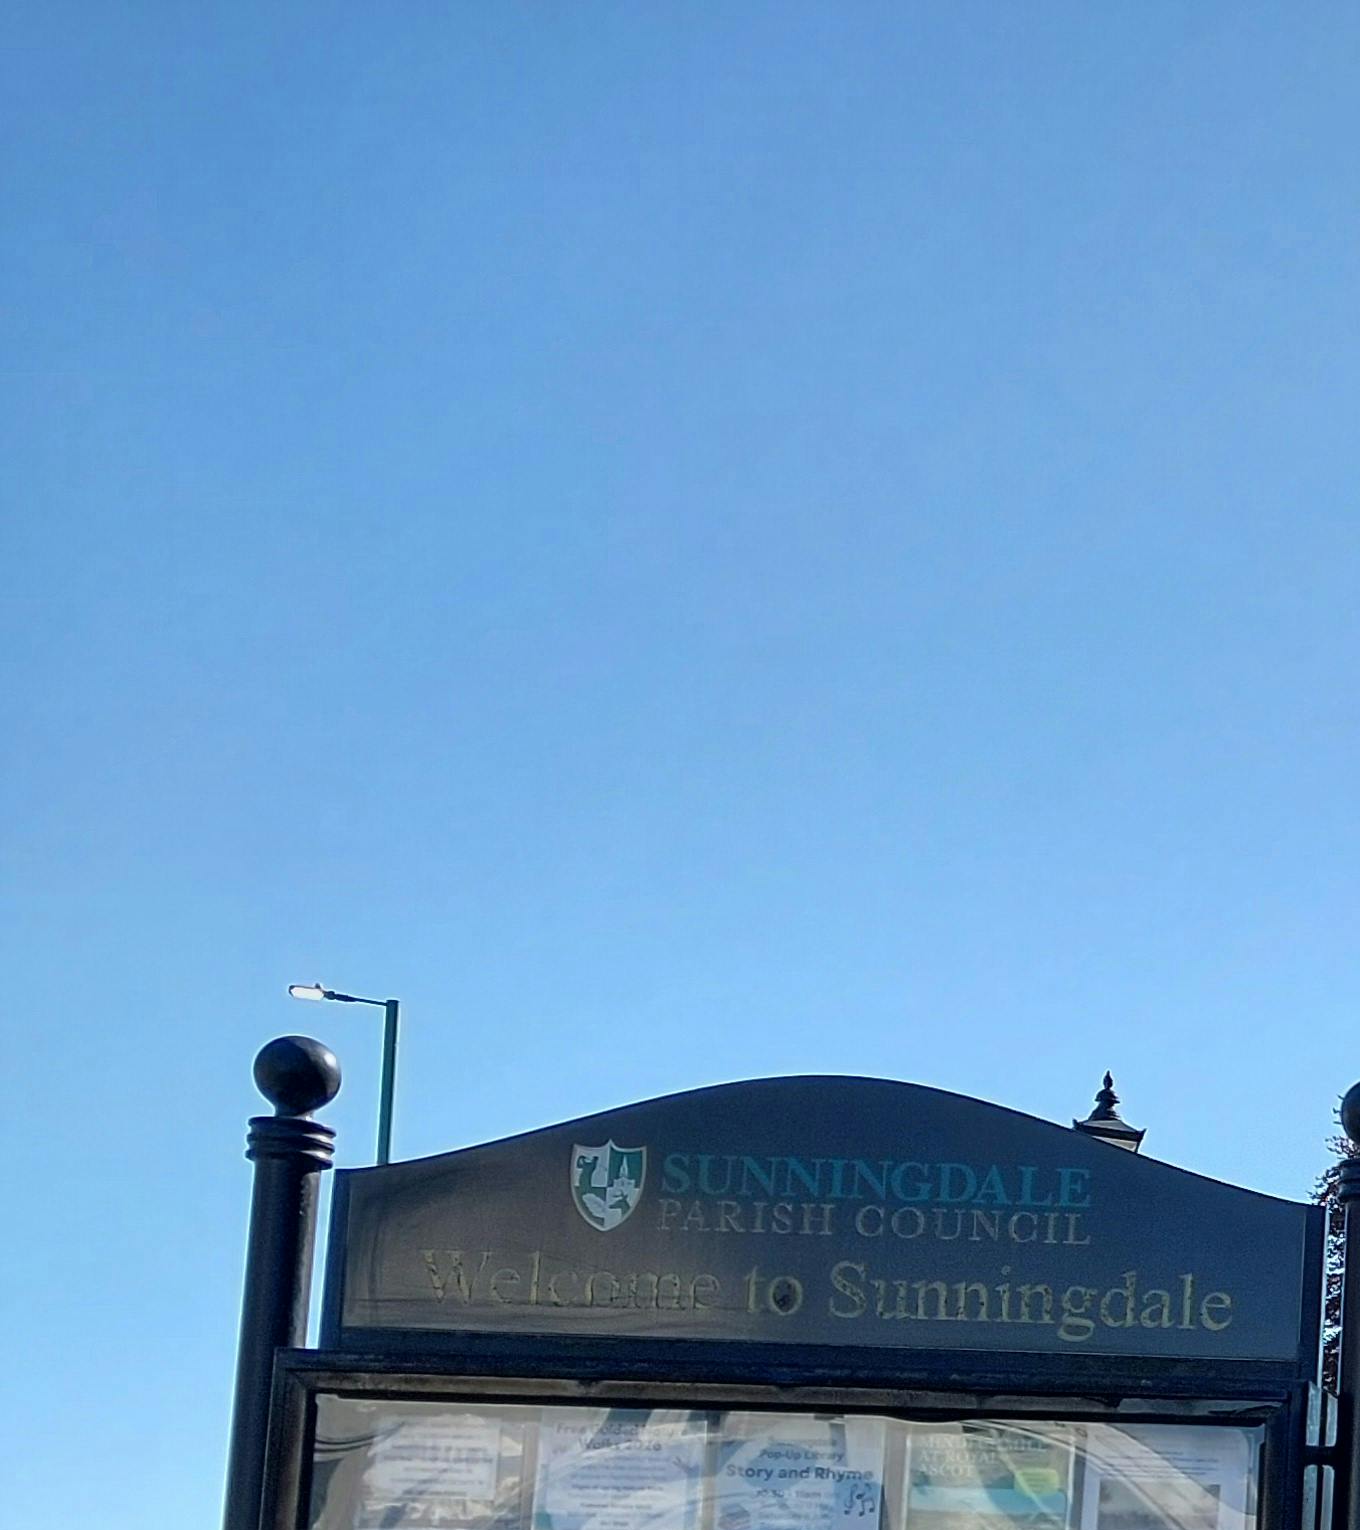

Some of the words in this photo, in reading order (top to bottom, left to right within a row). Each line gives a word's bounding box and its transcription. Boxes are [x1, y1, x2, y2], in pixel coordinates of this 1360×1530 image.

[662, 1152, 1092, 1208] SUNNINGDALE
[656, 1199, 834, 1237] PARISH
[855, 1205, 1092, 1246] COUNCIL
[420, 1249, 721, 1314] Welcome
[744, 1265, 803, 1316] to
[828, 1261, 1234, 1343] Sunningdale
[726, 1464, 774, 1481] Story
[777, 1466, 811, 1479] and
[814, 1467, 874, 1483] Rhyme
